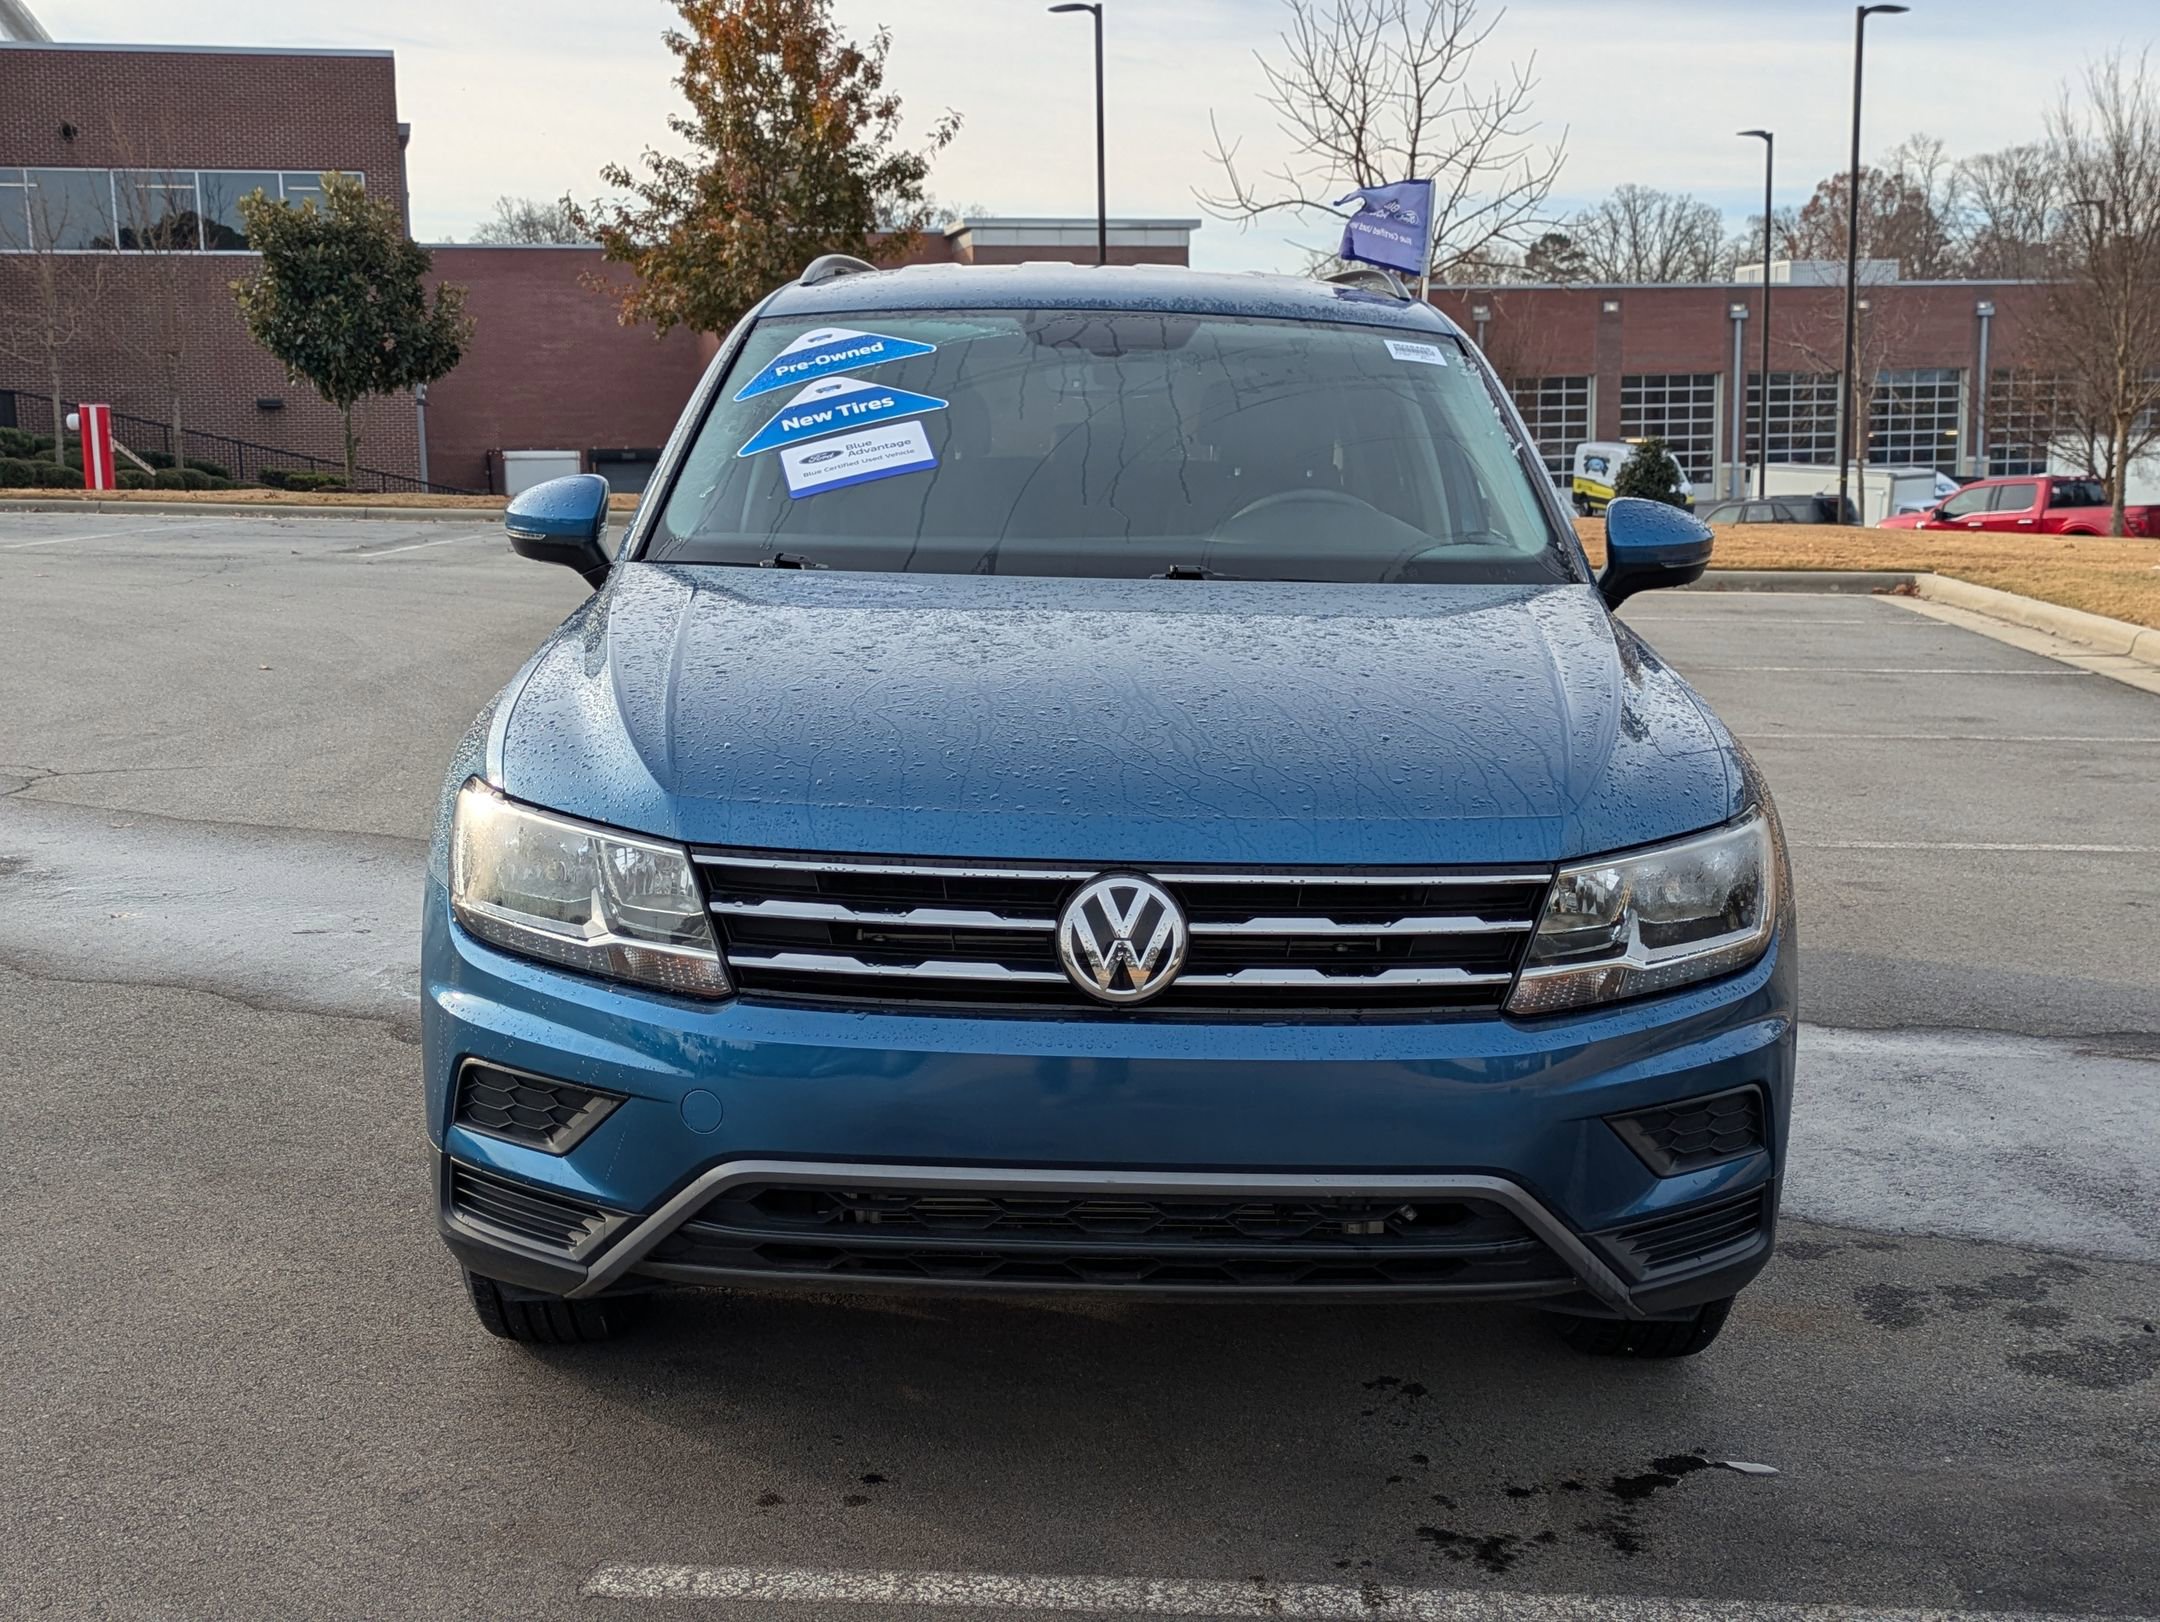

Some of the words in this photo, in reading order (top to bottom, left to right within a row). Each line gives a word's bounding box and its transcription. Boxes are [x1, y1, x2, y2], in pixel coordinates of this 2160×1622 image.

[775, 341, 885, 377] Pre-Owned
[781, 408, 833, 432] New
[835, 396, 895, 417] Tires
[845, 439, 873, 451] Blue
[848, 438, 912, 457] Advantage
[802, 469, 822, 478] Blue
[823, 459, 860, 473] Certified
[861, 454, 883, 464] Used
[884, 448, 915, 460] Vehicle
